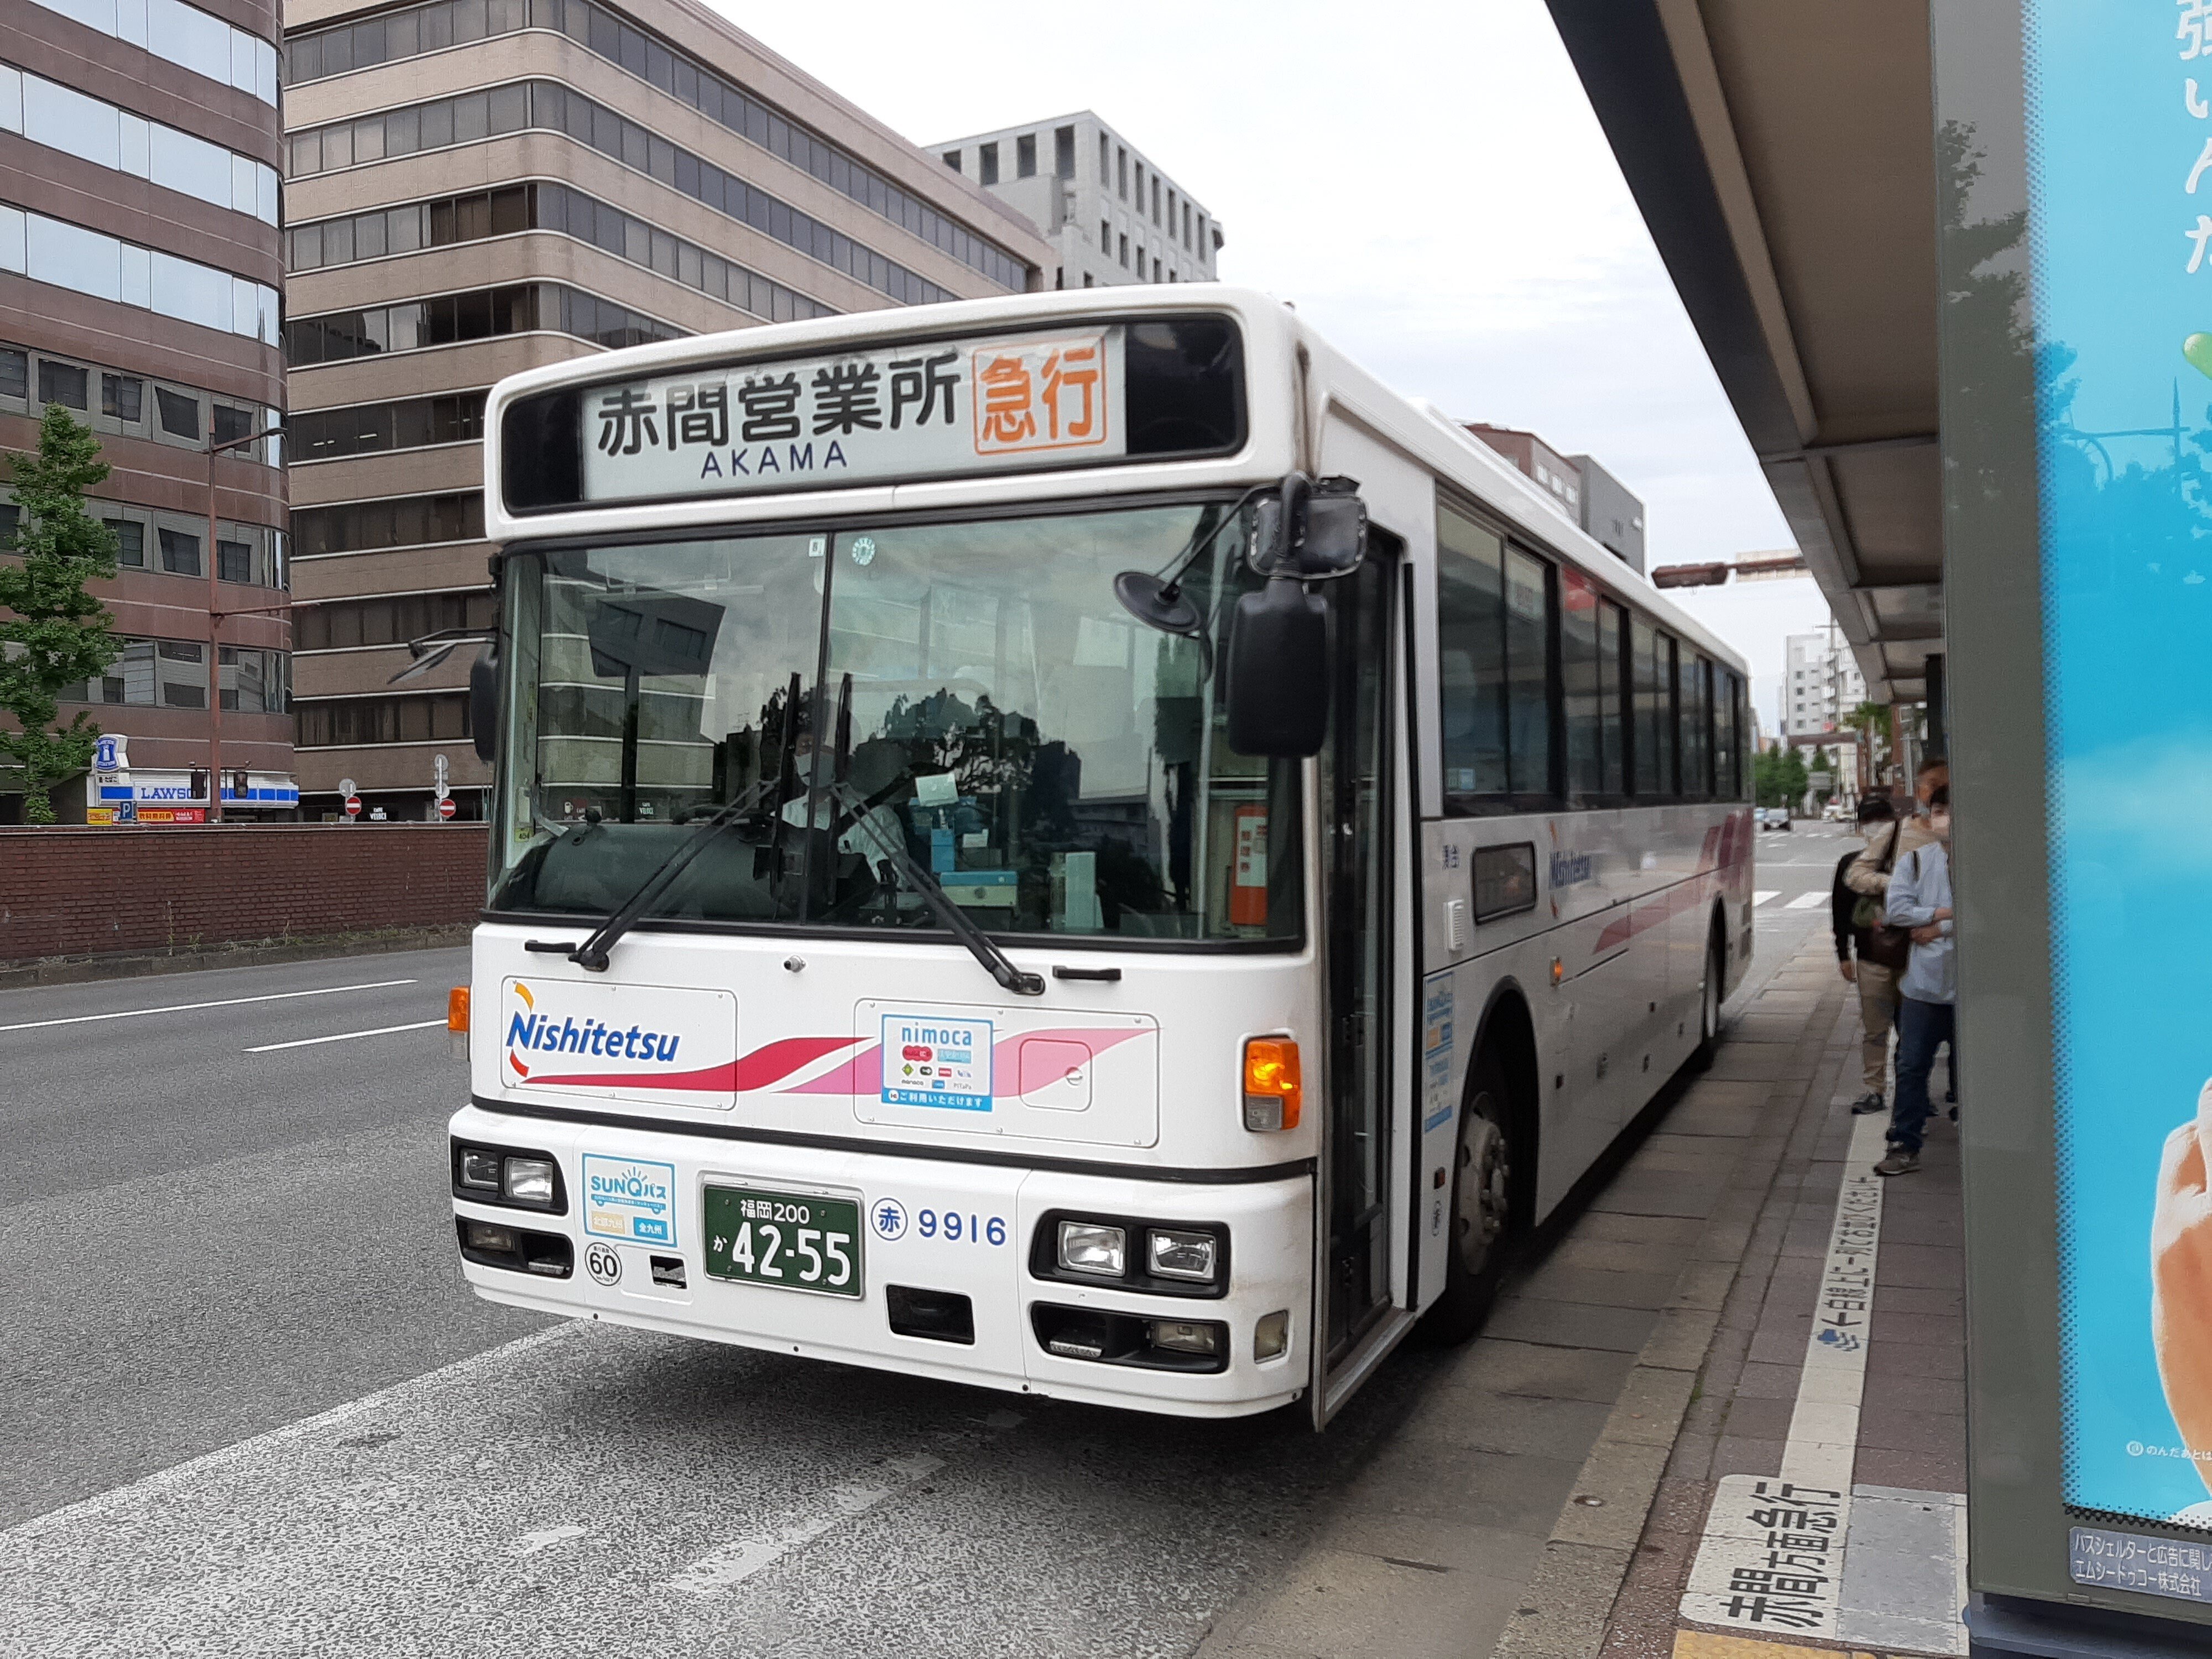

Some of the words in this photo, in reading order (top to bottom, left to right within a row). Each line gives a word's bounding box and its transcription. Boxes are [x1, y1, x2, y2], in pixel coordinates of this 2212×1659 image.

[598, 353, 961, 458] 赤間営業所
[979, 348, 1099, 445] 急行
[701, 440, 848, 479] AKAMA
[505, 1010, 680, 1062] Nishitetsu
[901, 1022, 972, 1046] nimoca
[878, 1206, 901, 1233] 赤
[918, 1209, 1007, 1246] 9916
[589, 1252, 618, 1277] 60
[712, 1234, 728, 1253] か
[732, 1221, 852, 1287] 42-55
[1719, 1481, 1841, 1629] 赤間方面急行
